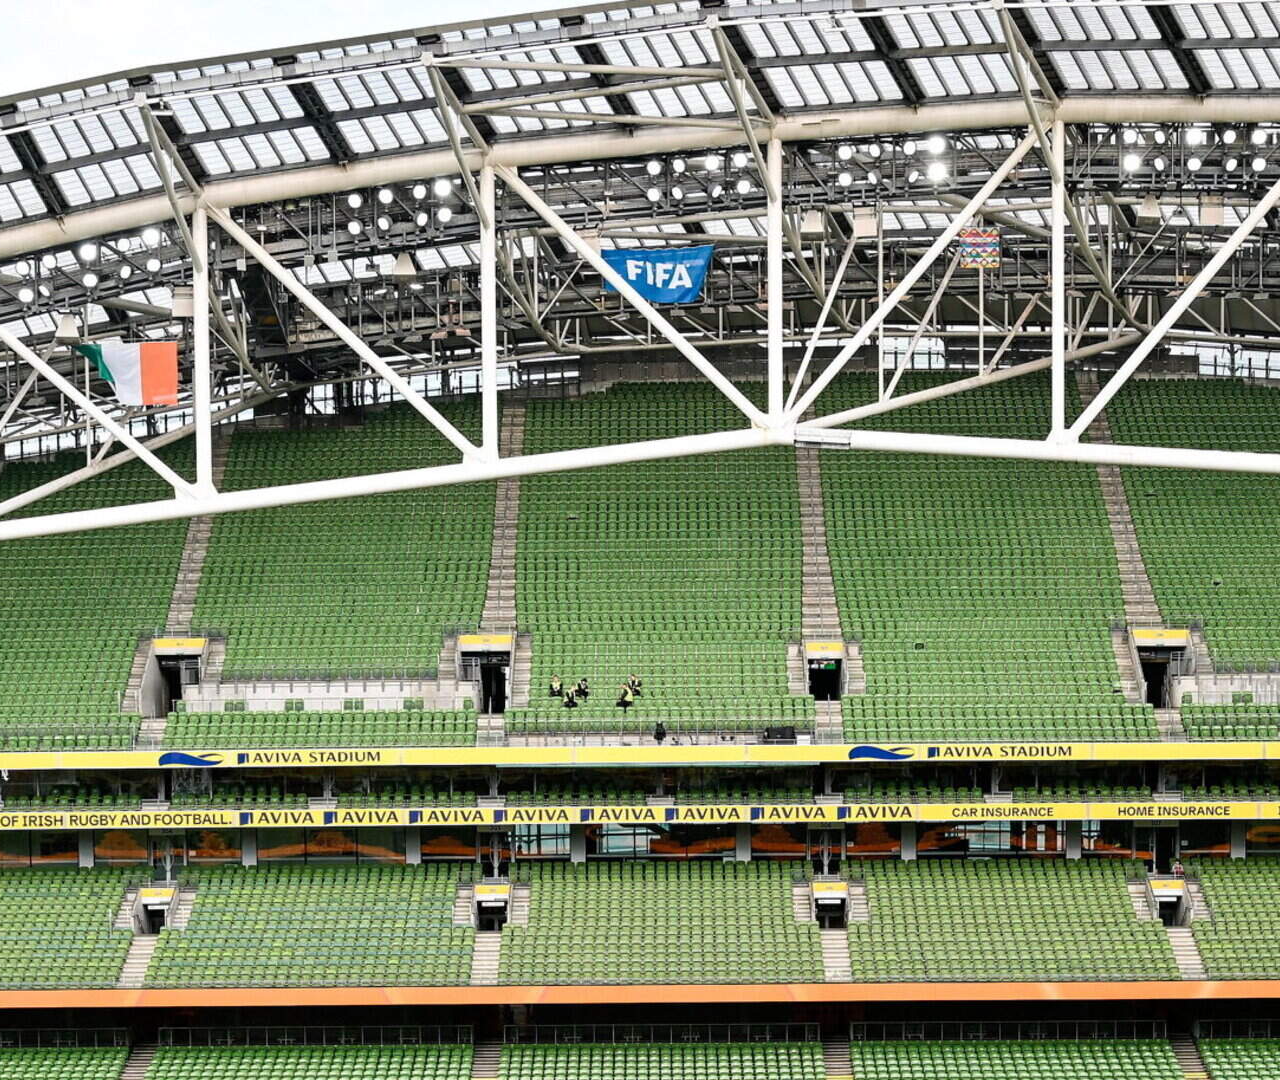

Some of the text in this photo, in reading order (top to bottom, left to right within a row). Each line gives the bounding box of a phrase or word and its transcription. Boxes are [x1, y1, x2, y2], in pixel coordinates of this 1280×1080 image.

[626, 259, 693, 289] FIFA
[254, 752, 380, 762] AVIVA STADIUM
[944, 746, 1071, 757] AVIVA STADIUM
[428, 811, 484, 822] AVIVA
[512, 809, 568, 821] AVIVA
[599, 809, 655, 820] AVIVA
[684, 808, 740, 819] AVIVA
[769, 807, 825, 818] AVIVA
[856, 806, 912, 818] AVIVA
[952, 808, 1053, 817] CAR INSURANCE
[1118, 806, 1230, 816] HOME INSURANCE
[0, 816, 18, 827] OF
[23, 816, 63, 827] IRISH
[70, 815, 116, 826] RUGBY
[120, 815, 151, 825] AND
[154, 814, 231, 825] FOOTBALL.
[258, 812, 314, 824] AVIVA
[343, 811, 398, 823] AVIVA
